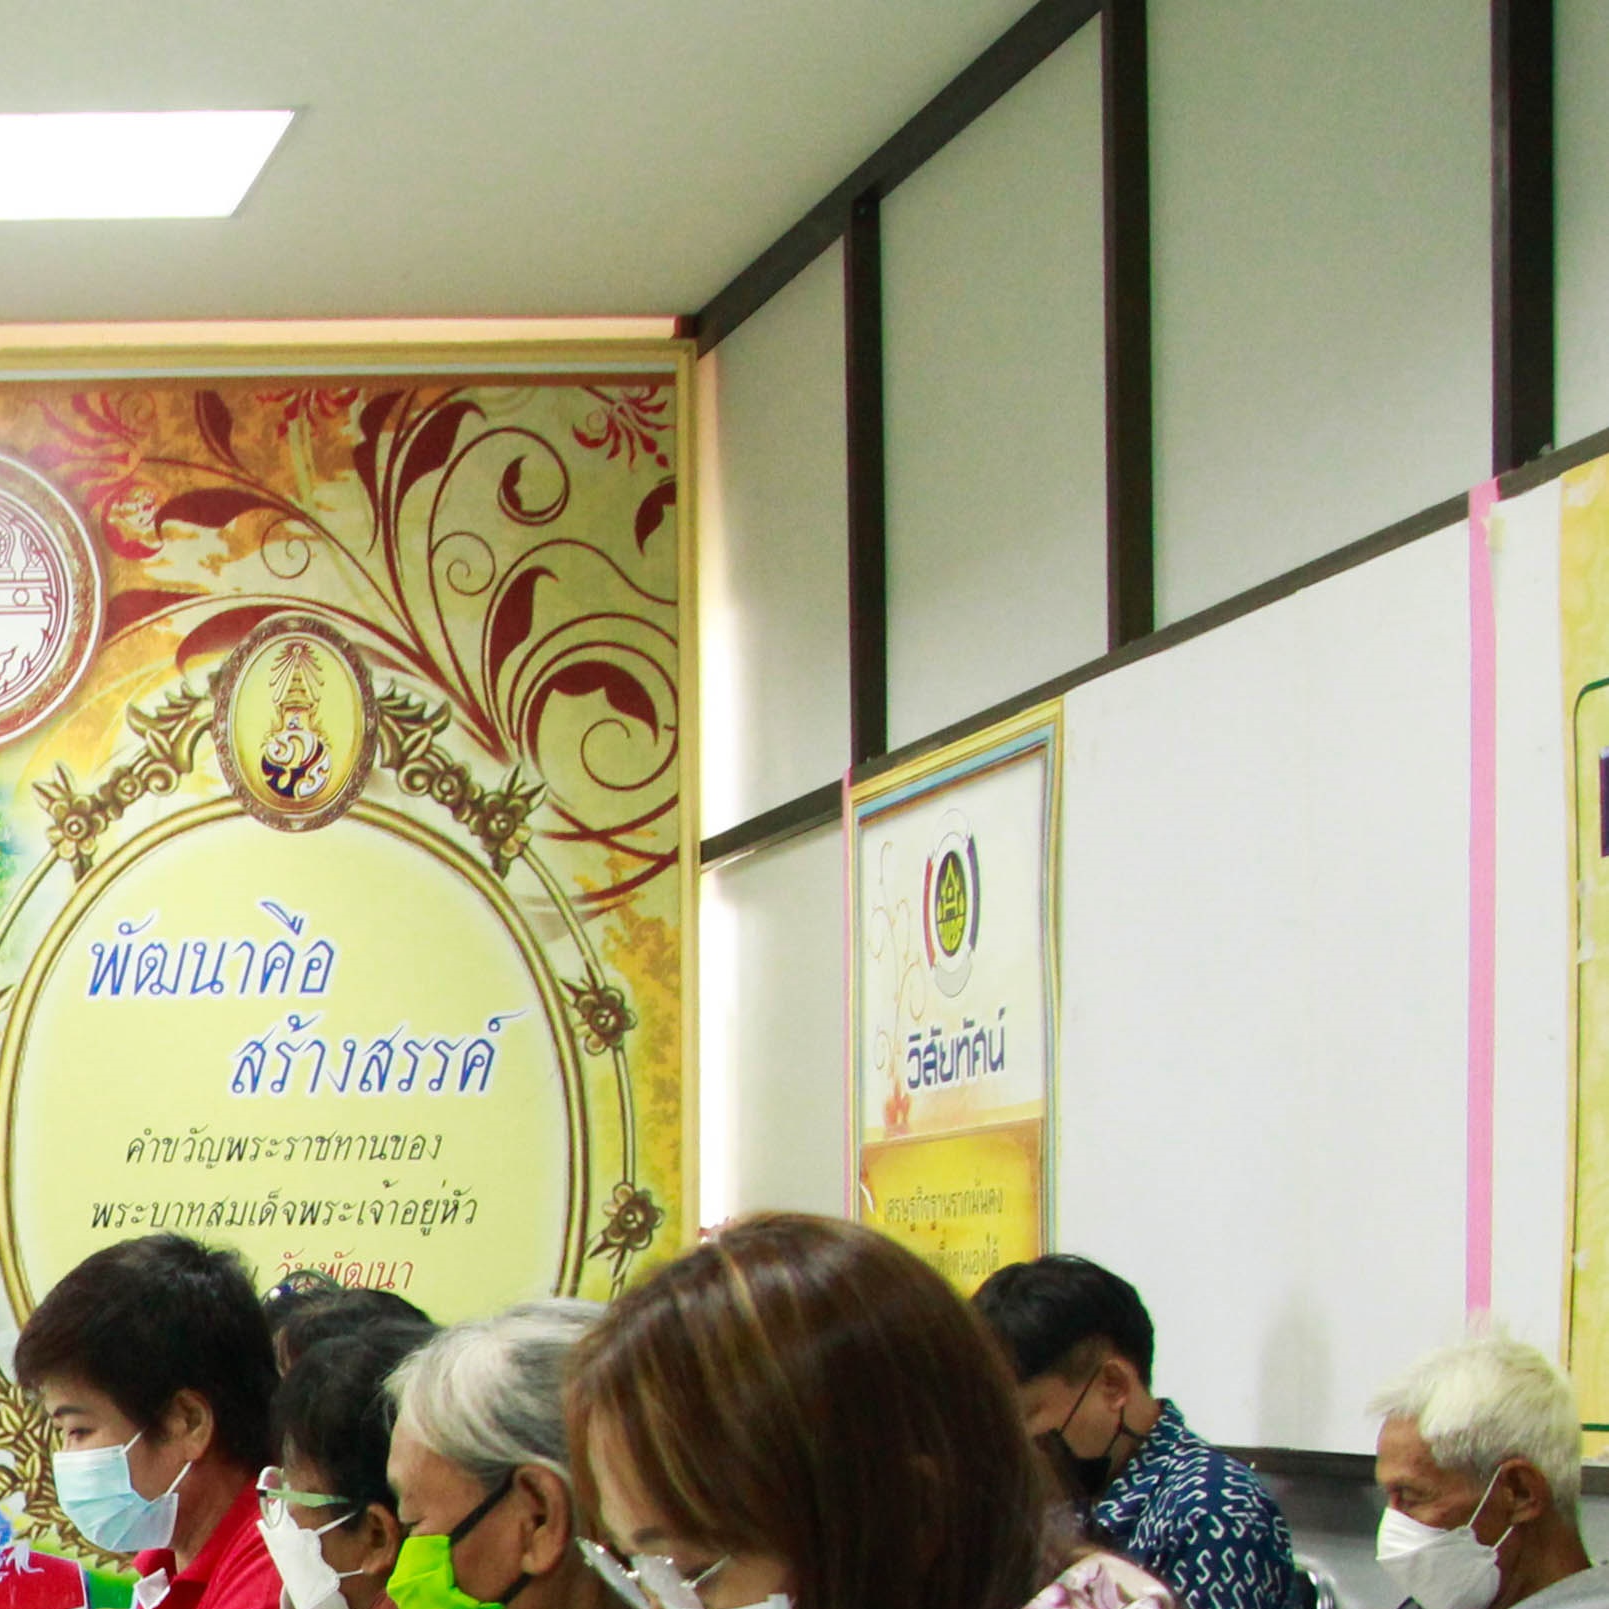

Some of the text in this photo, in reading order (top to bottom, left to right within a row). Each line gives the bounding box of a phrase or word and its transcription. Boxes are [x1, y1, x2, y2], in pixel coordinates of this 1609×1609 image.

[88, 902, 334, 997] พัฒนาคือ
[231, 1010, 524, 1094] สร้างสรรค์
[126, 1124, 443, 1170] คำขวัญพระราชทานของ
[91, 1179, 479, 1237] พระบาทสมเด็จพระเจ้าอยู่หัว
